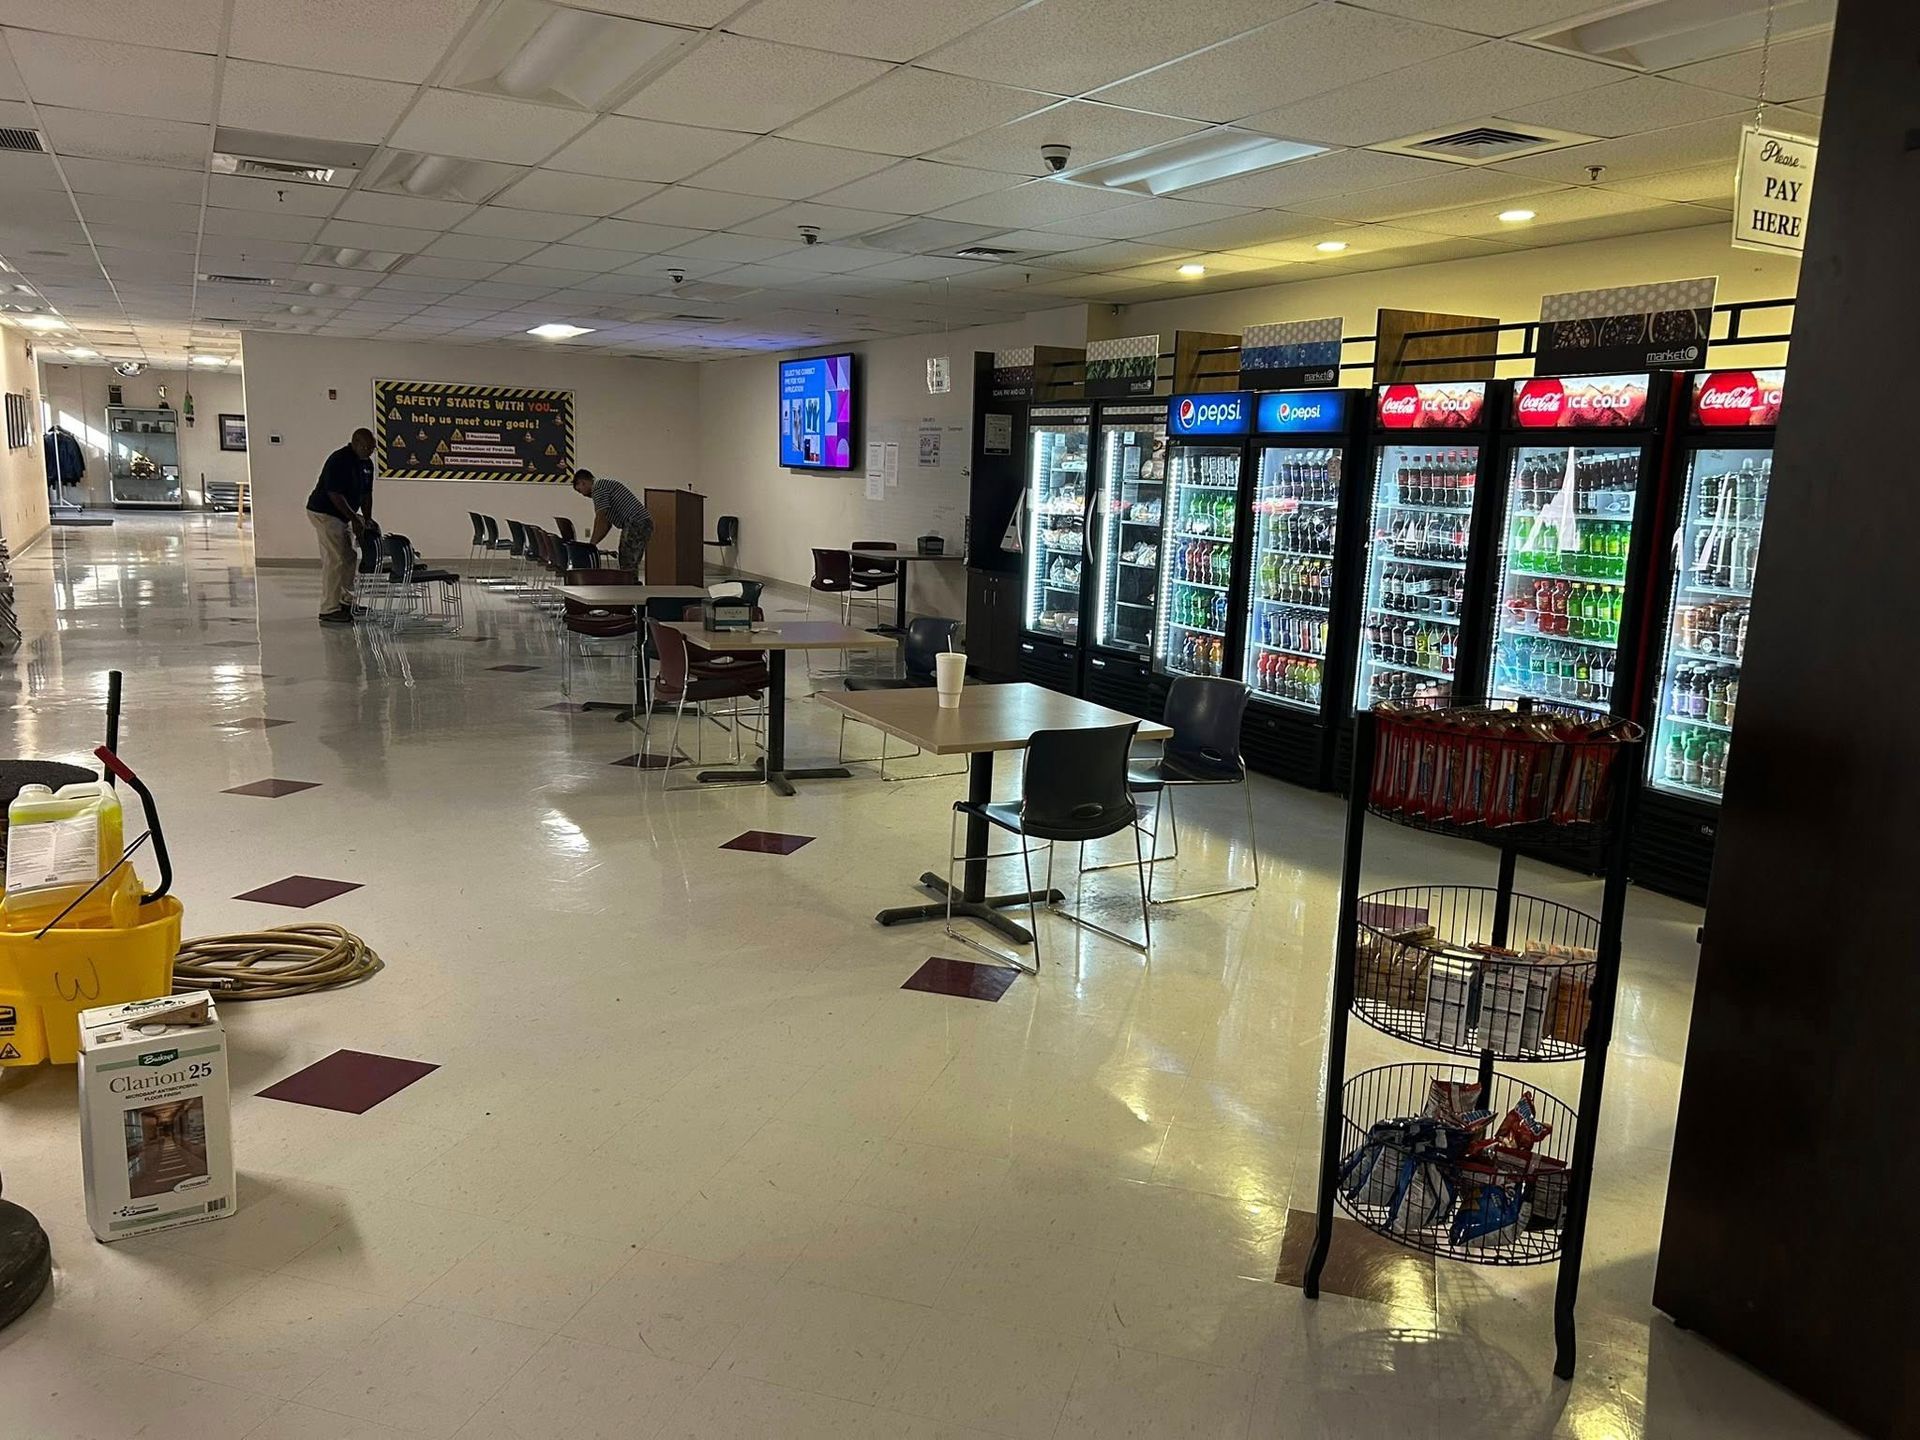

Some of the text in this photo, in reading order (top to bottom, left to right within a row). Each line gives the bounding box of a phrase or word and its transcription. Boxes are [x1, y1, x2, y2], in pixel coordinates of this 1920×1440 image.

[1764, 177, 1803, 203] PAY
[1752, 209, 1802, 238] HERE
[394, 394, 441, 406] SAFETY
[446, 398, 491, 410] STARTS
[495, 400, 524, 412] WITH
[1382, 396, 1471, 414] Coca-Cola ICE COLD
[1519, 393, 1631, 412] Coca-Cola ICE COLD
[1700, 386, 1782, 410] Coca-Cola IC
[412, 412, 540, 430] help us meet our goals!
[1197, 399, 1242, 426] pepsi
[1290, 404, 1320, 420] pepsi
[110, 1062, 212, 1094] Clarion 25
